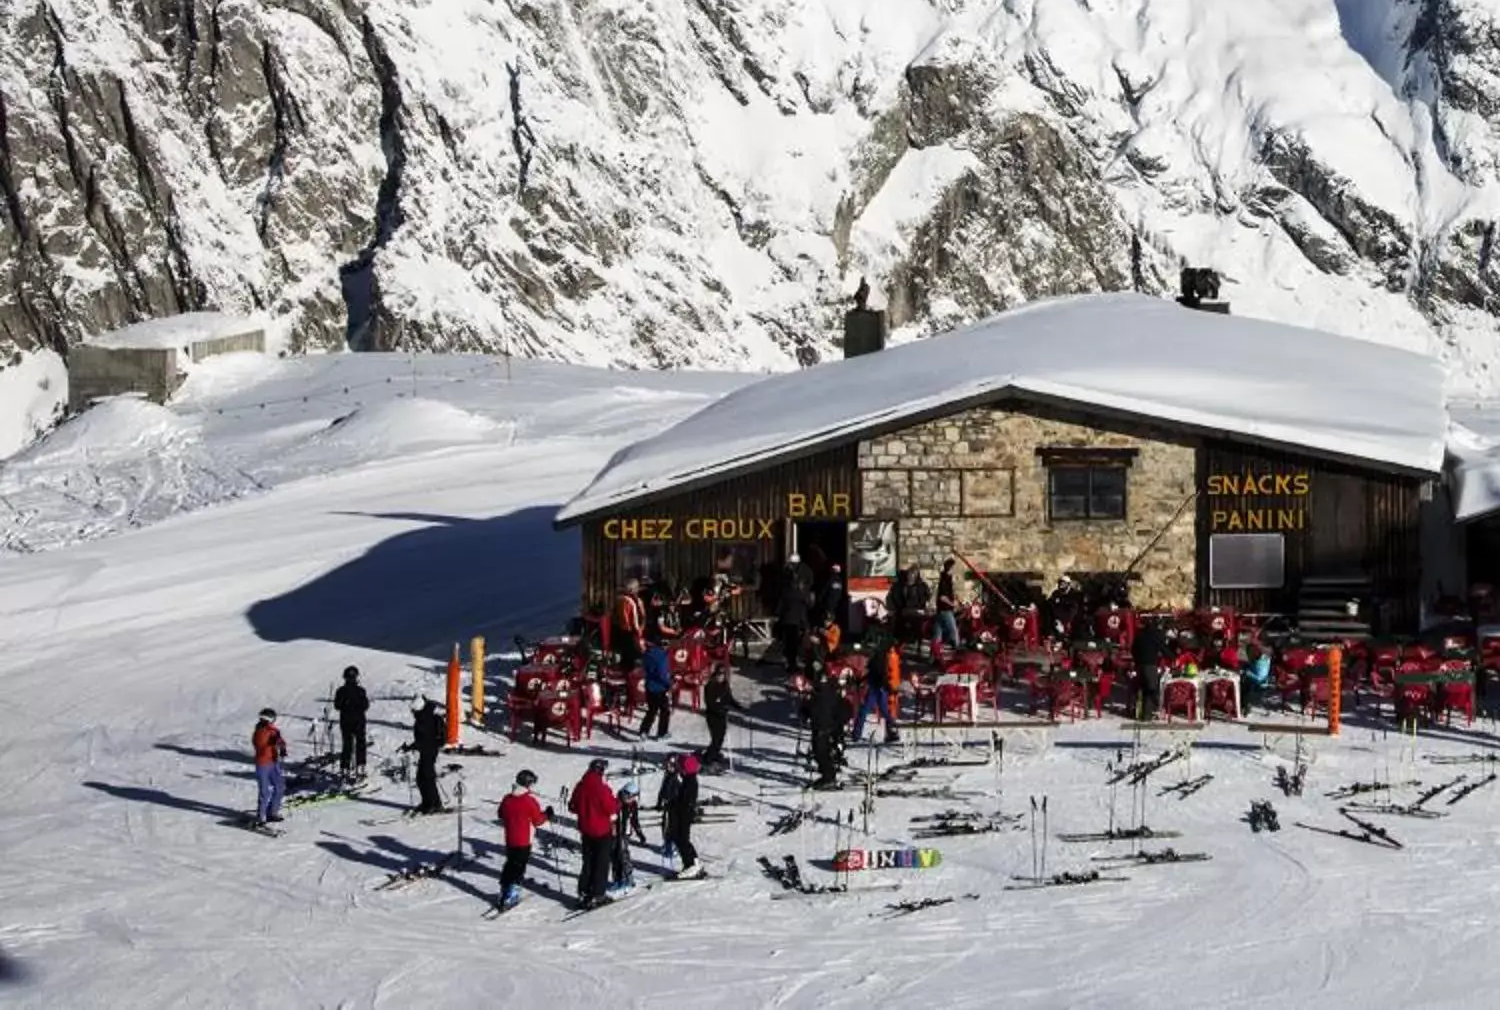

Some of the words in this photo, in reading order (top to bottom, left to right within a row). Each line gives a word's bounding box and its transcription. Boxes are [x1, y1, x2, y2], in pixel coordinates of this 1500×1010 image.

[1207, 474, 1309, 496] SNACKS
[789, 493, 851, 517] BAR
[603, 519, 673, 540] CHEZ
[685, 519, 774, 540] CROUX
[1212, 509, 1305, 530] PANINI
